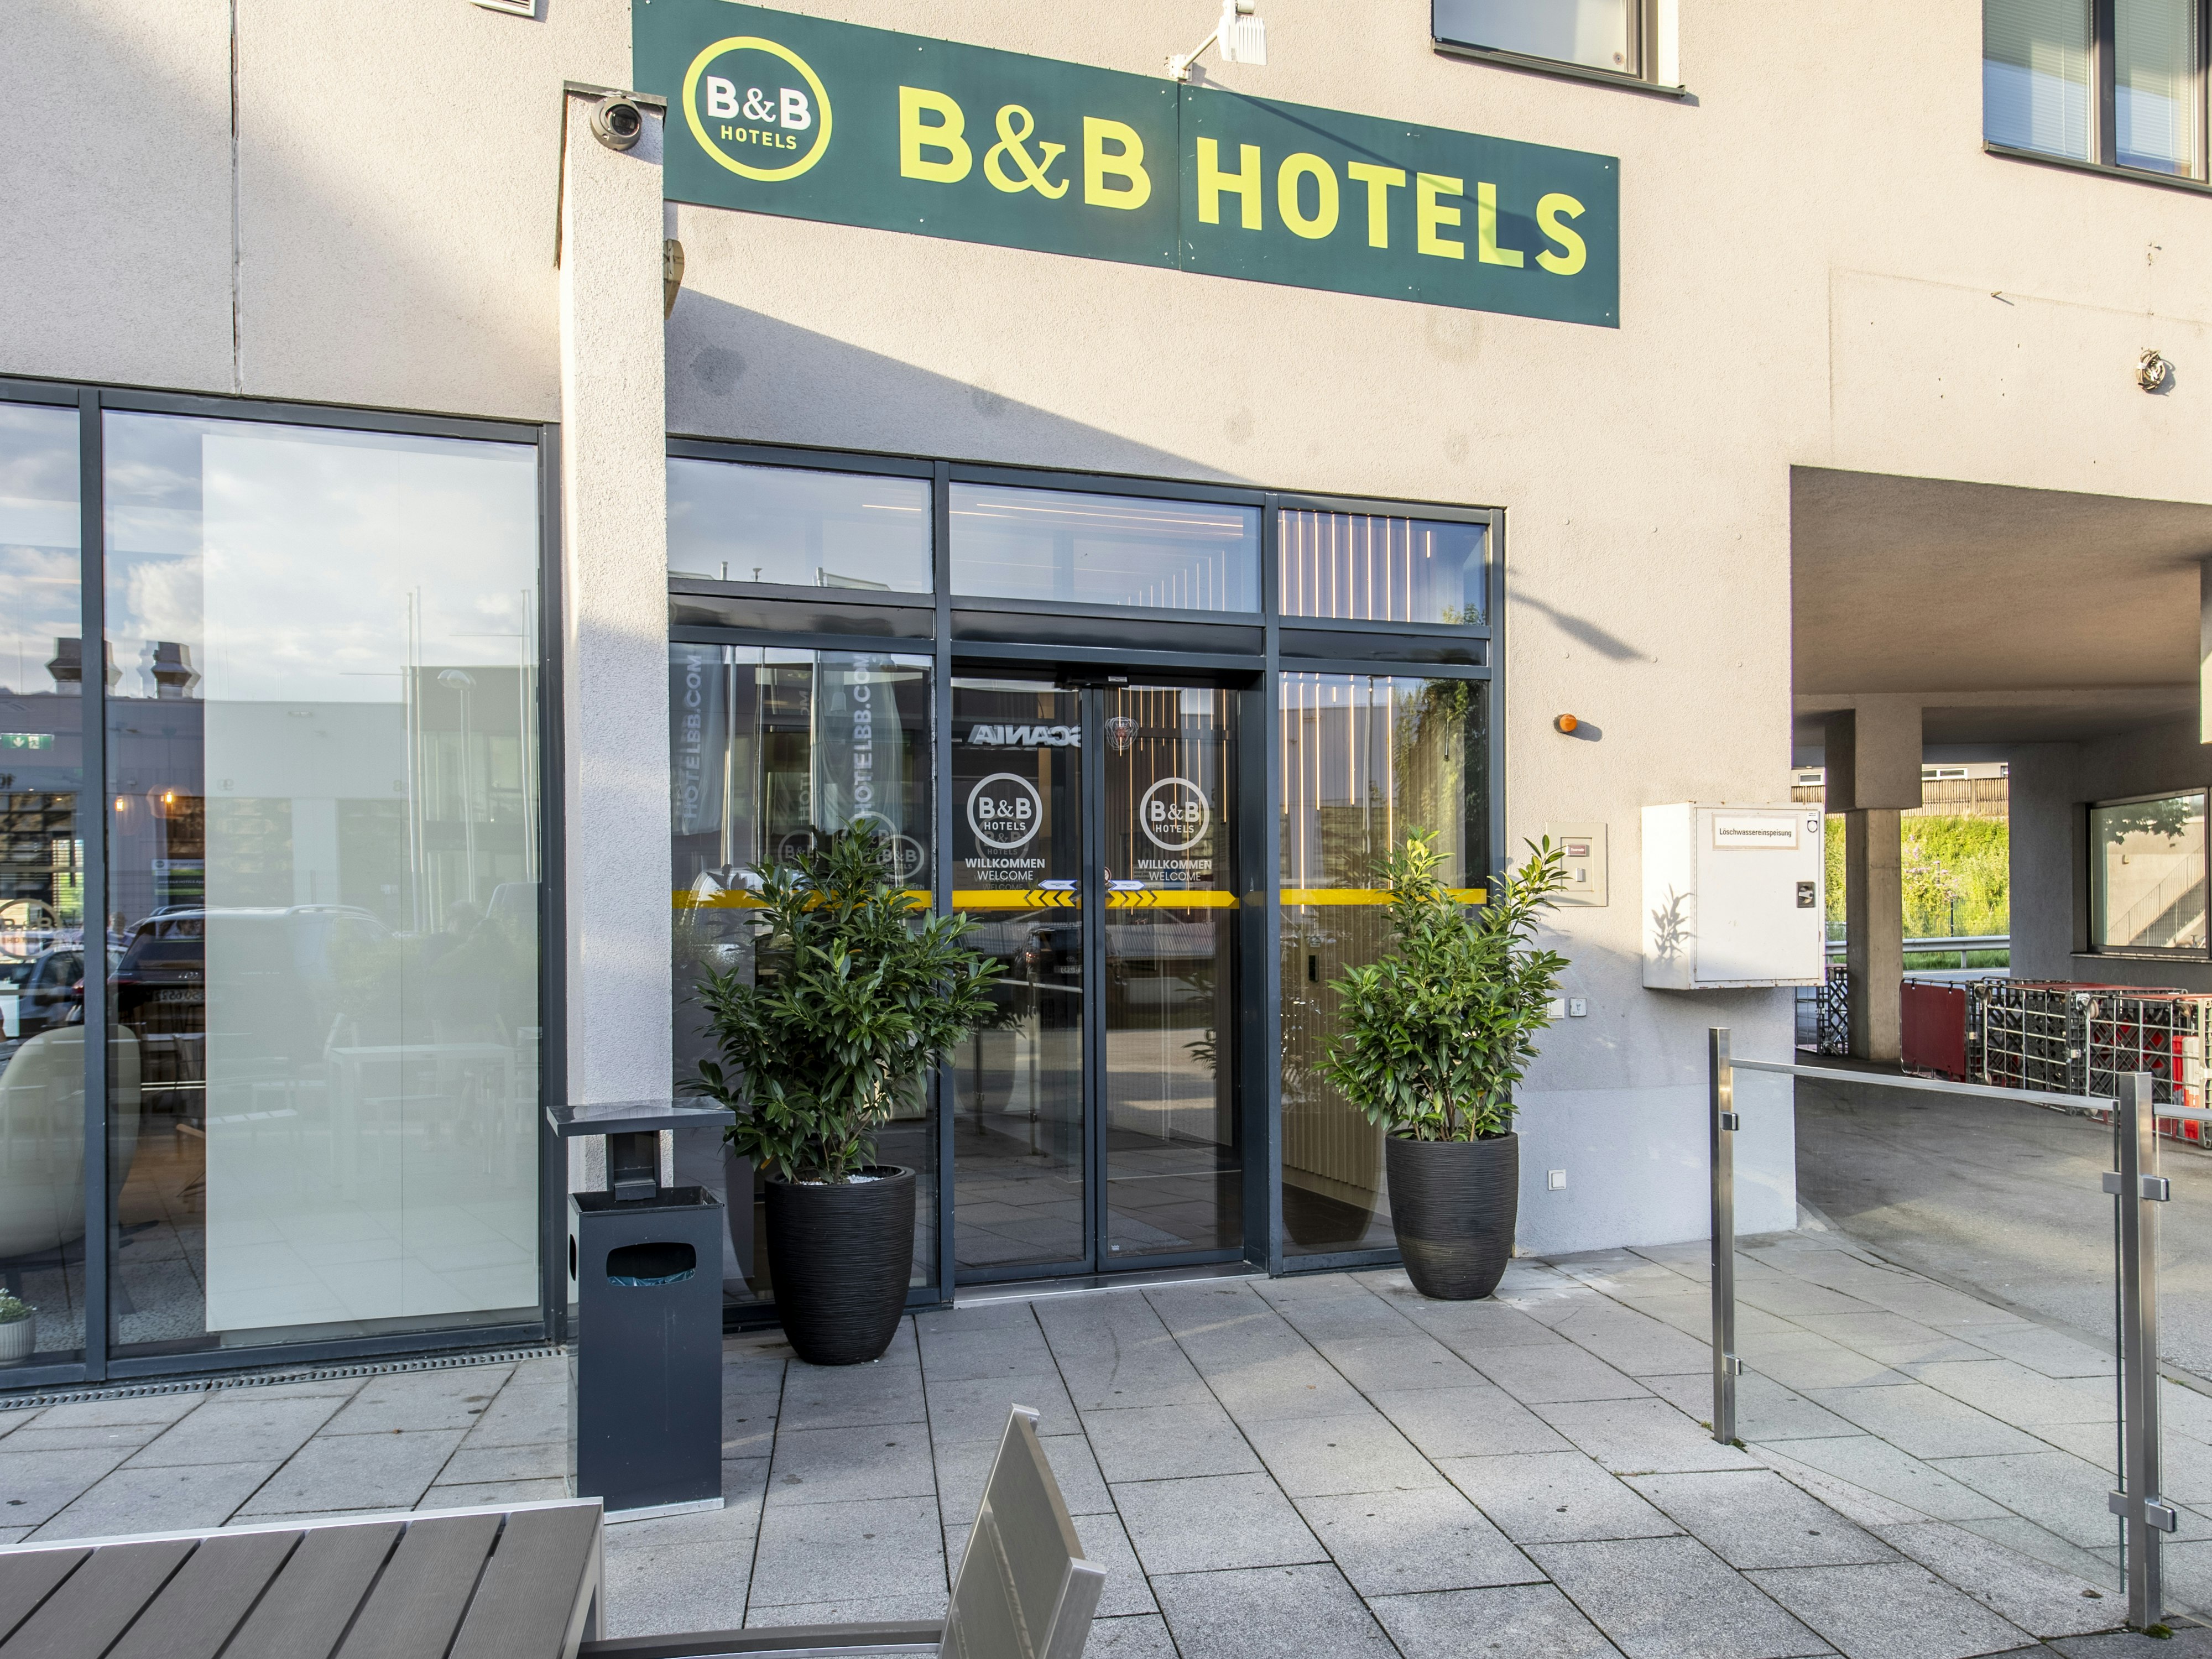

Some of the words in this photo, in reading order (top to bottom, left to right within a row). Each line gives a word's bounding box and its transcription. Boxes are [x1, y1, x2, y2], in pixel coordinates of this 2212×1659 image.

[707, 76, 811, 131] B&B
[721, 125, 797, 150] HOTELS
[899, 85, 1151, 211] B&B
[1197, 137, 1587, 275] HOTELS
[853, 654, 873, 819] HOTELBB.COM
[979, 797, 1032, 819] B&B
[1151, 801, 1199, 822] B&B
[984, 822, 1026, 831] HOTELS
[1156, 825, 1194, 833] HOTELS
[1719, 828, 1792, 838] Löschwassereinspeisung
[965, 858, 1045, 868] WILLKOMMEN
[1138, 859, 1212, 869] WILLKOMMEN
[977, 870, 1034, 880] WELCOME
[1149, 872, 1201, 881] WELCOME
